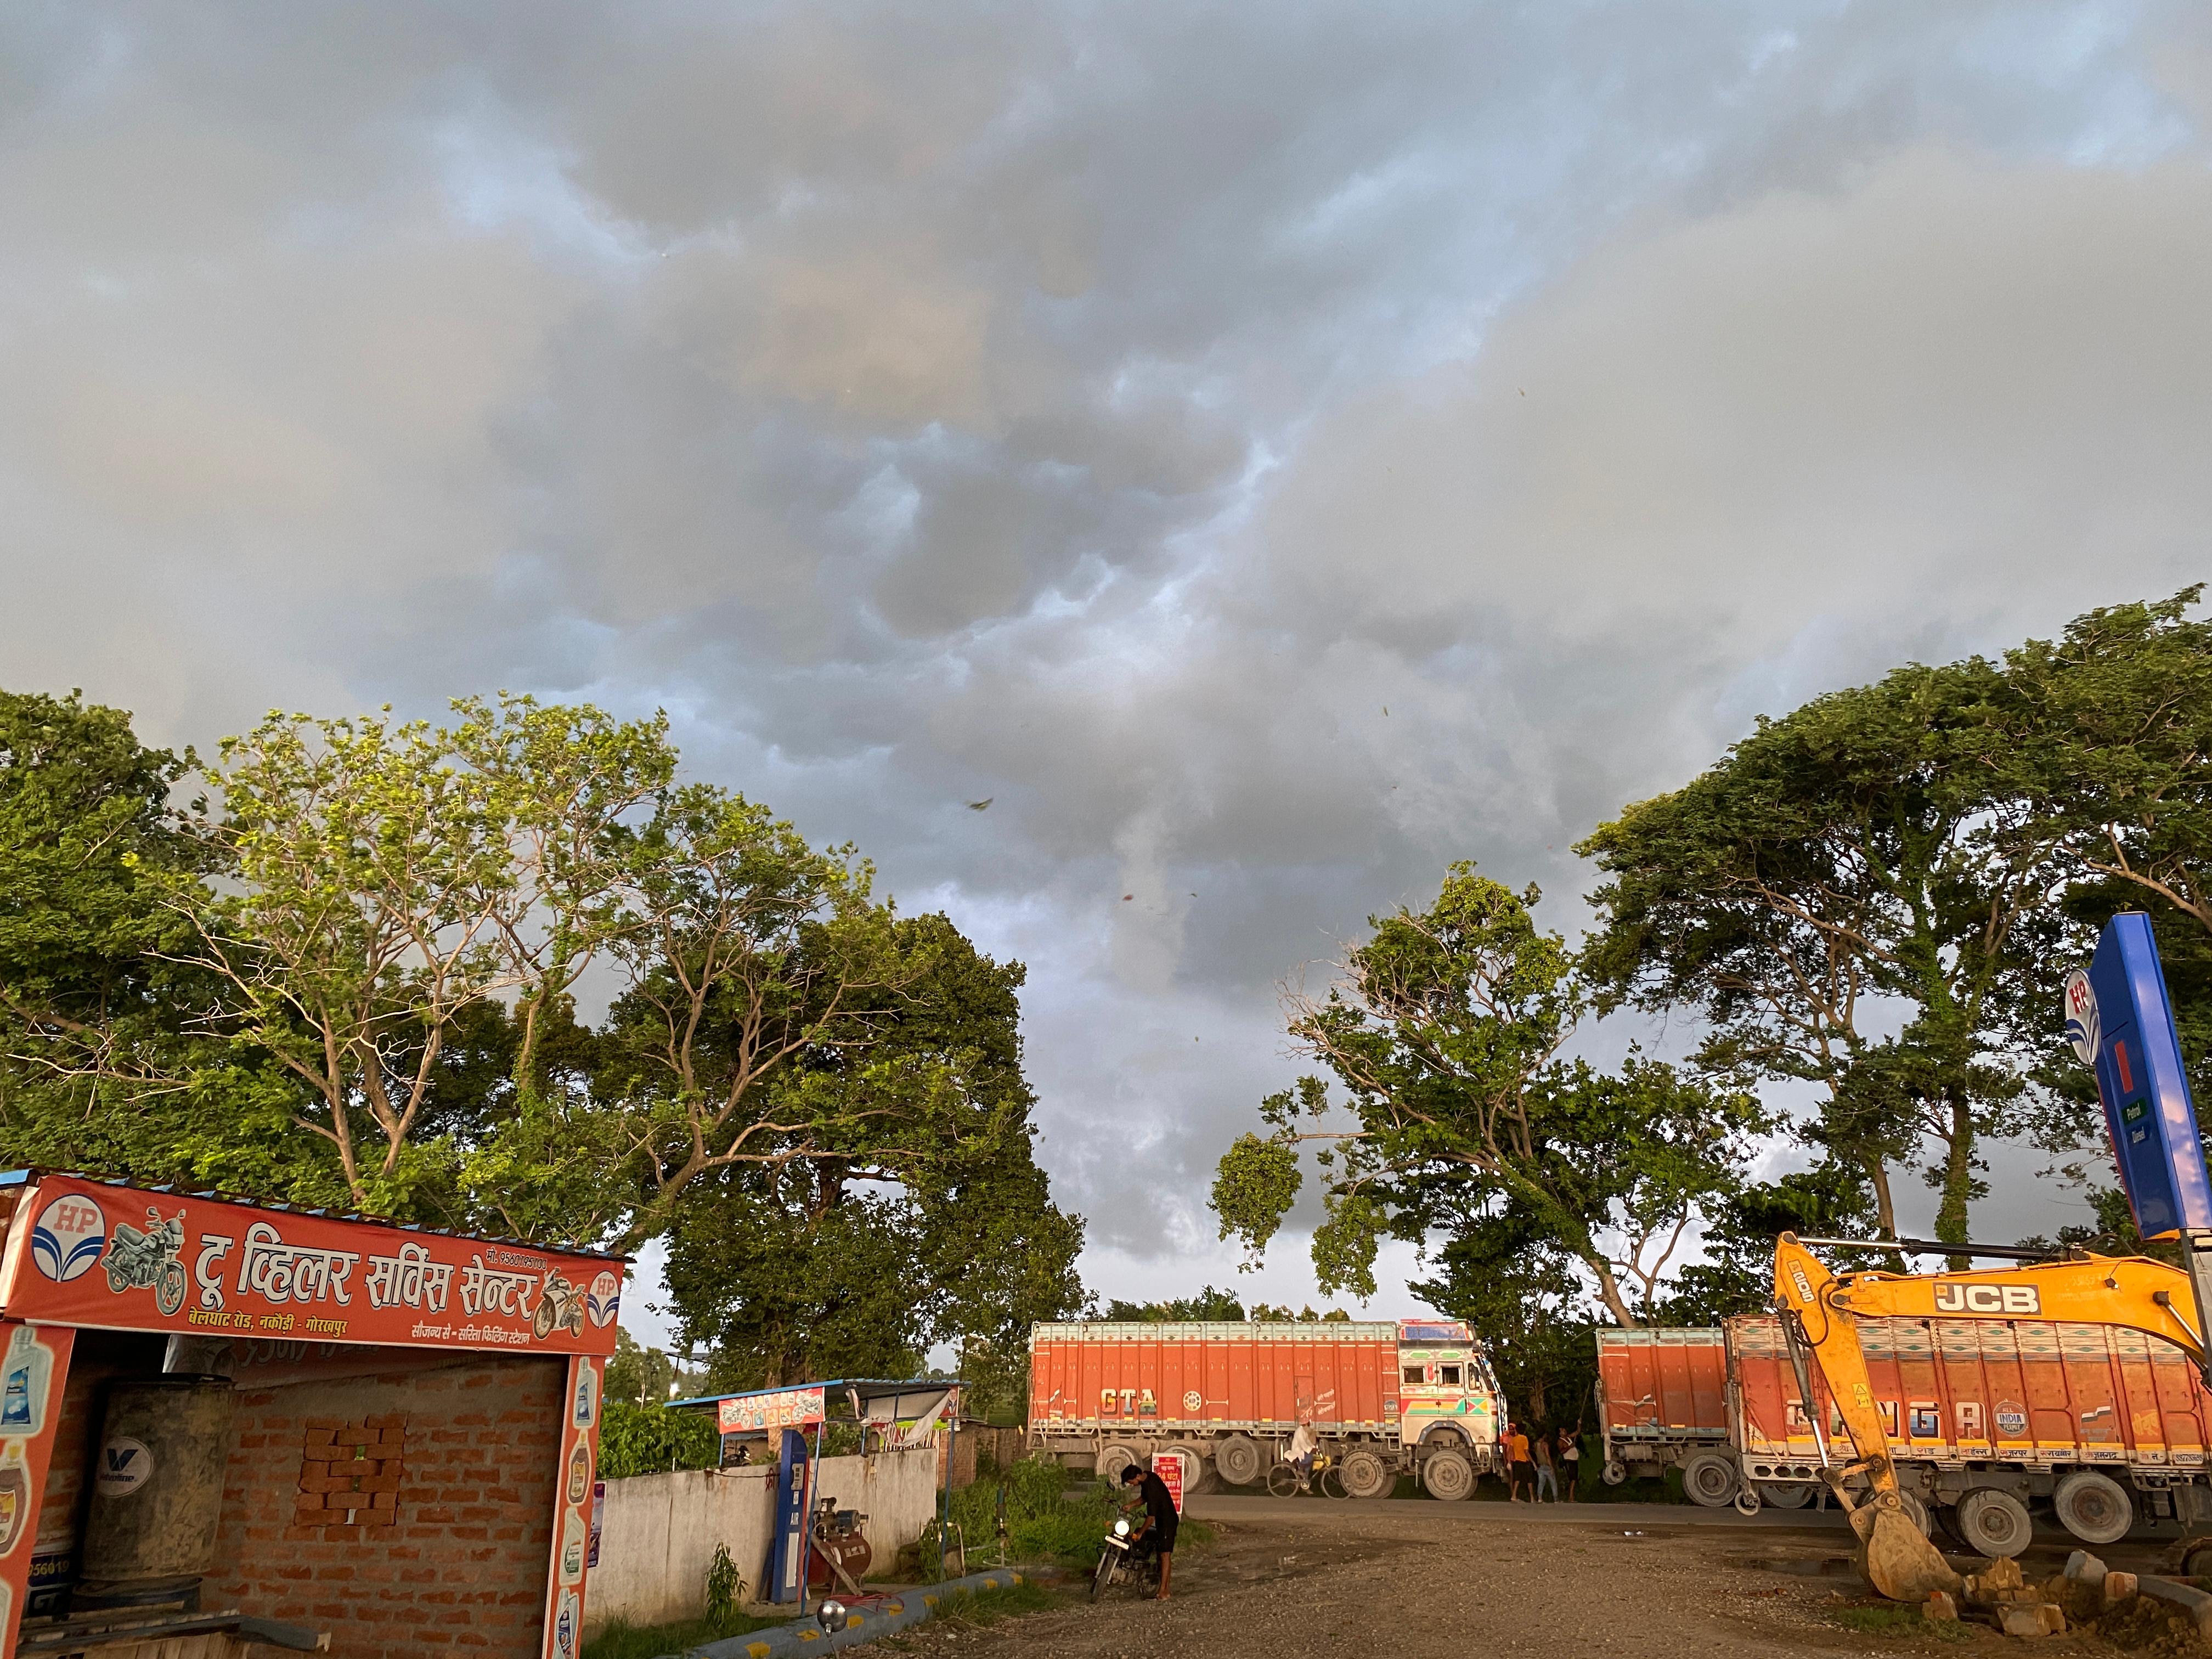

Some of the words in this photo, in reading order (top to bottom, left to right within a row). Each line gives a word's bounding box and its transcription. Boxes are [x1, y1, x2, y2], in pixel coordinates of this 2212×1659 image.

[2069, 980, 2088, 1015] HP
[2126, 1102, 2141, 1121] Petrol
[2132, 1126, 2146, 1143] Diesel
[54, 1204, 97, 1233] HP
[486, 1246, 497, 1263] मो.
[195, 1233, 234, 1310] टू
[236, 1221, 361, 1306] व्हिलर
[365, 1241, 455, 1314] सर्विस
[459, 1254, 539, 1321] सेन्टर
[596, 1278, 615, 1296] HP
[1937, 1285, 2039, 1313] JCB
[188, 1306, 232, 1327] बेलघाट
[233, 1310, 254, 1331] रोड,
[306, 1314, 348, 1338] गोरखपुर
[411, 1320, 443, 1339] सौजन्य
[443, 1323, 451, 1339] से
[459, 1324, 482, 1341] सरिता
[482, 1325, 509, 1343] फिलिंग
[509, 1328, 531, 1344] स्टेशन
[1101, 1389, 1157, 1415] GTA
[1999, 1414, 2022, 1423] INDIA
[790, 1512, 799, 1525] AIR
